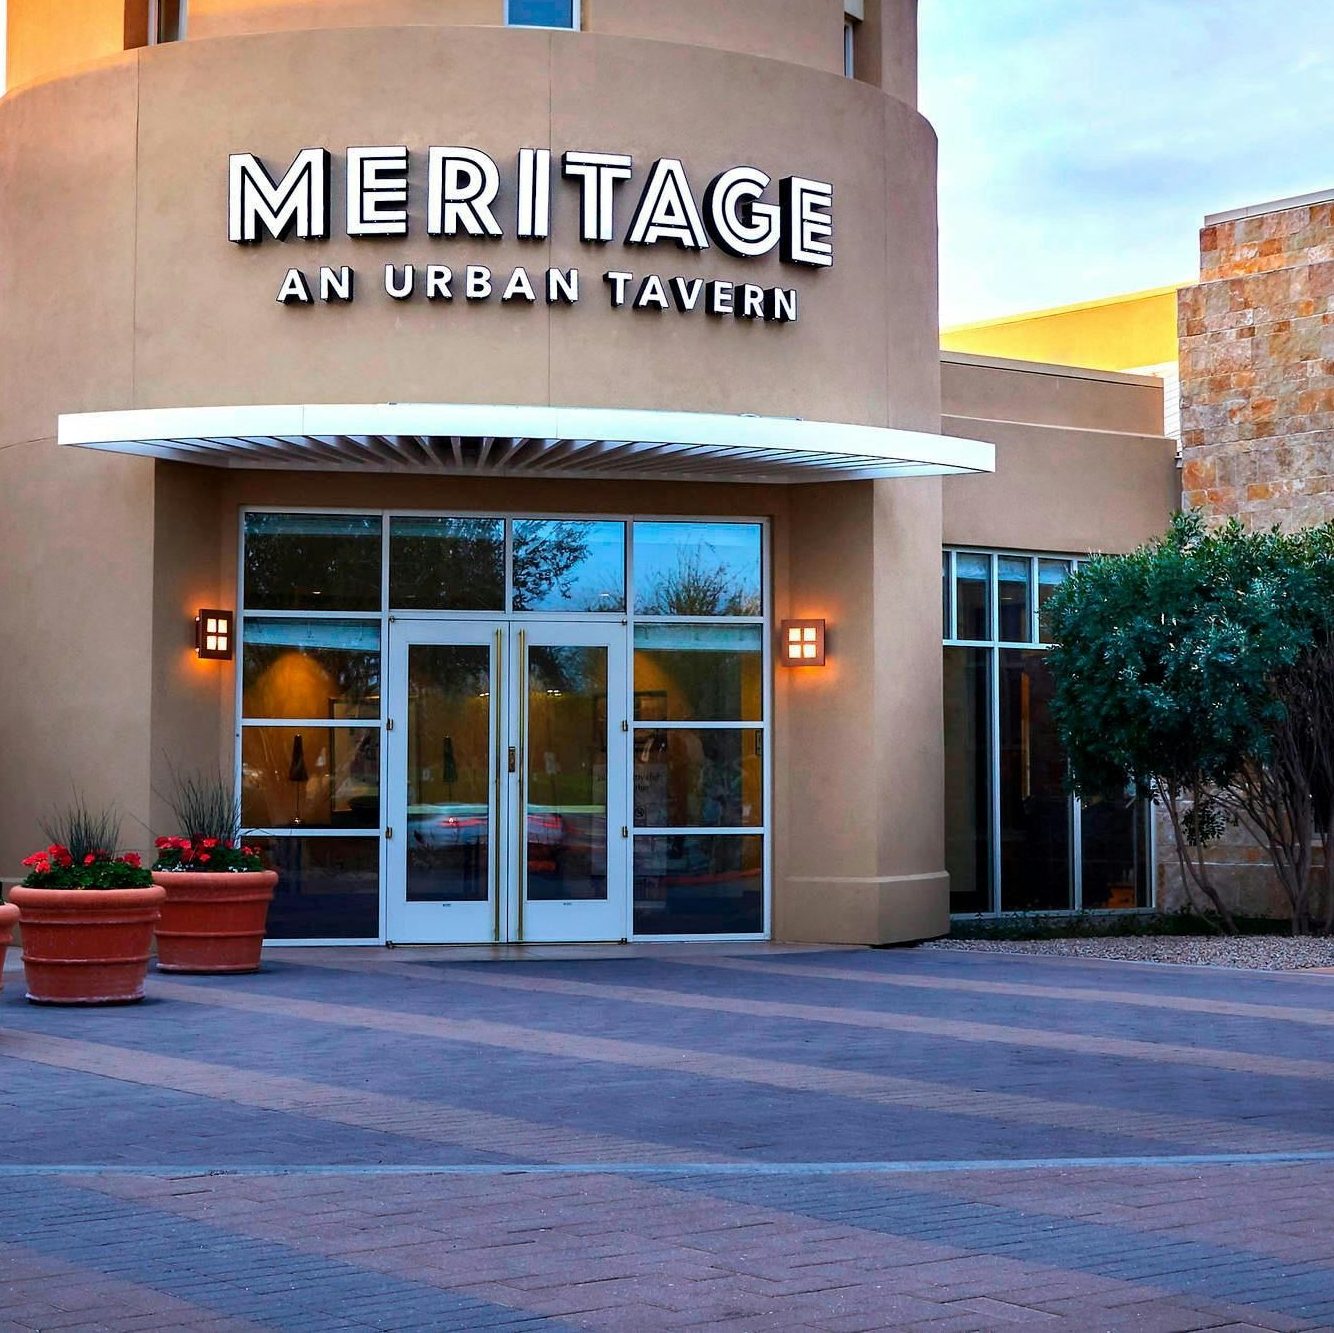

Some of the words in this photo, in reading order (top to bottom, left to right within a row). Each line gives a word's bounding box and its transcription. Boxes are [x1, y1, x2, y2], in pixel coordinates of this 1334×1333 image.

[228, 146, 834, 267] MERITAGE
[275, 266, 354, 304] AN
[383, 264, 580, 304] URBAN
[603, 271, 799, 323] TAVERN
